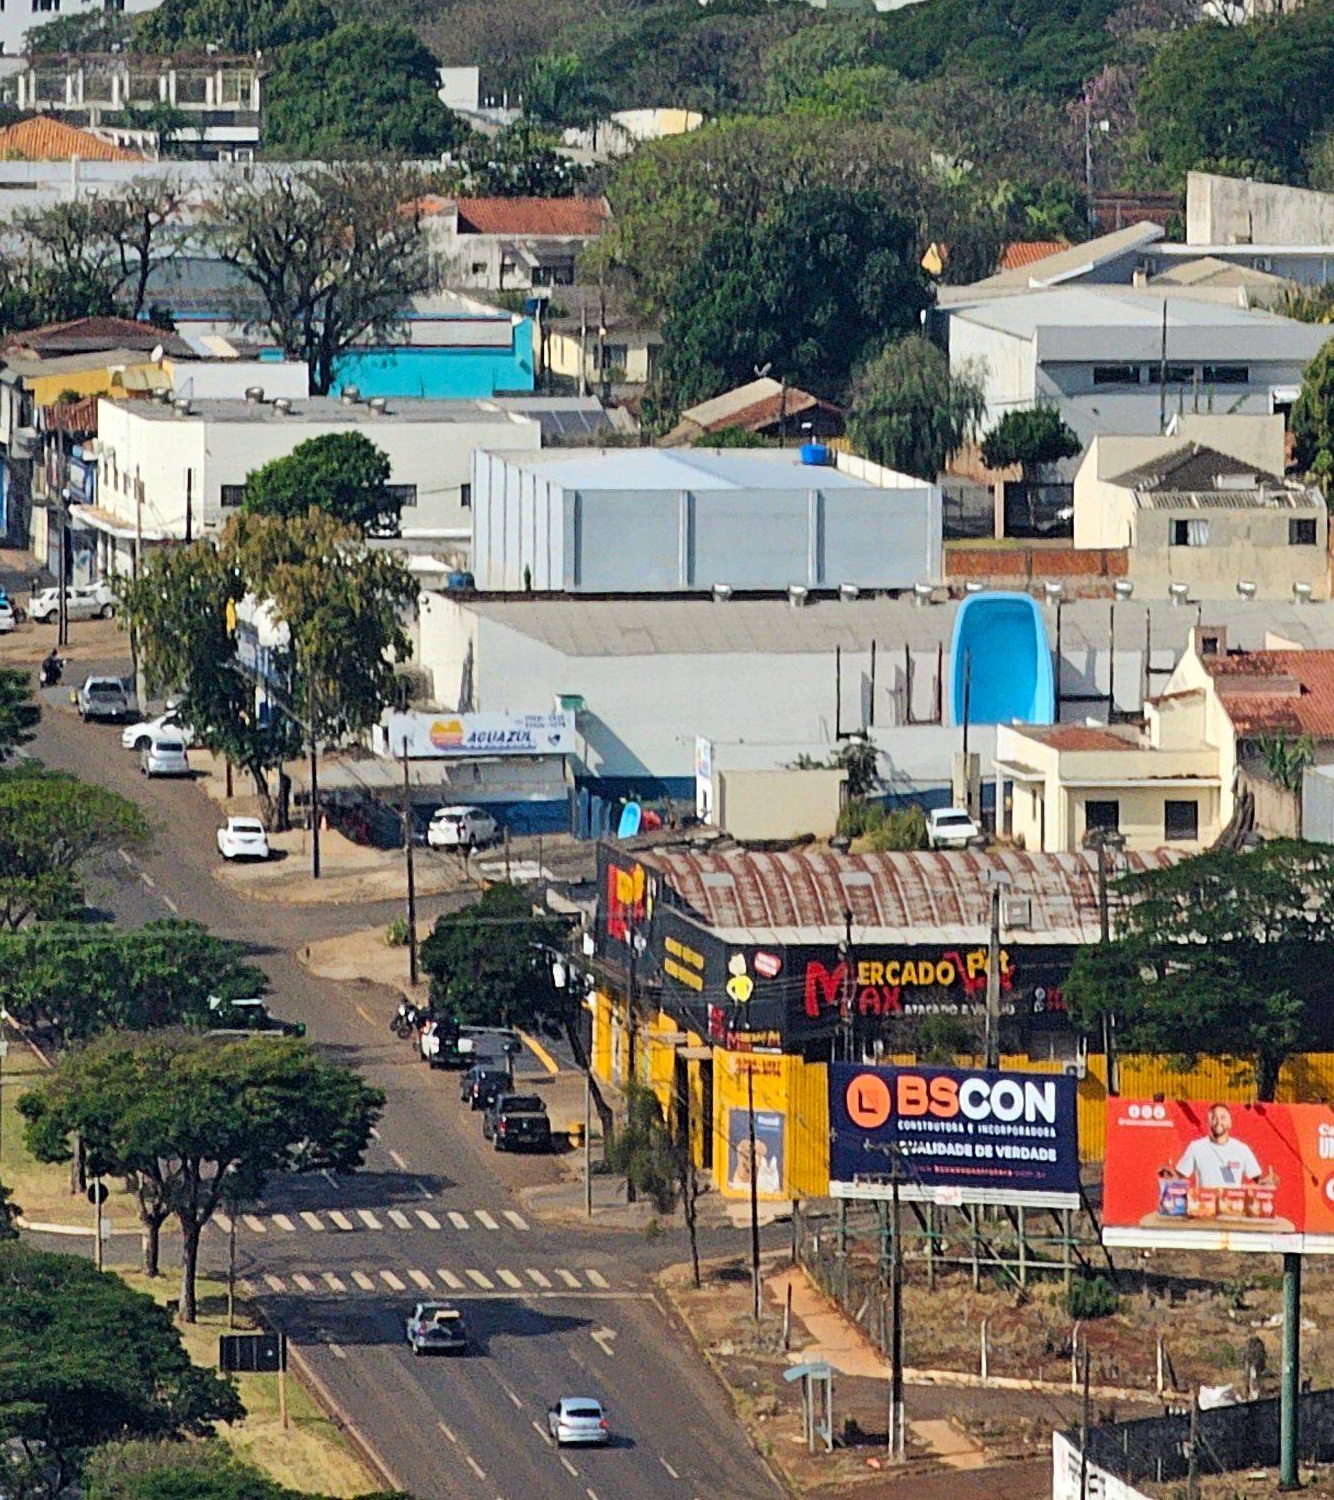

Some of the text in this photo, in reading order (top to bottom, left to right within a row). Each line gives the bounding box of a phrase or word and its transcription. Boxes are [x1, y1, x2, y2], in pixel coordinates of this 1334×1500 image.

[897, 1075, 1057, 1124] BSCON
[897, 1119, 965, 1134] CONSTRUTORA
[977, 1124, 1057, 1138] INCORPORADORA
[974, 1143, 993, 1158] DE
[995, 1145, 1057, 1163] VERDADE
